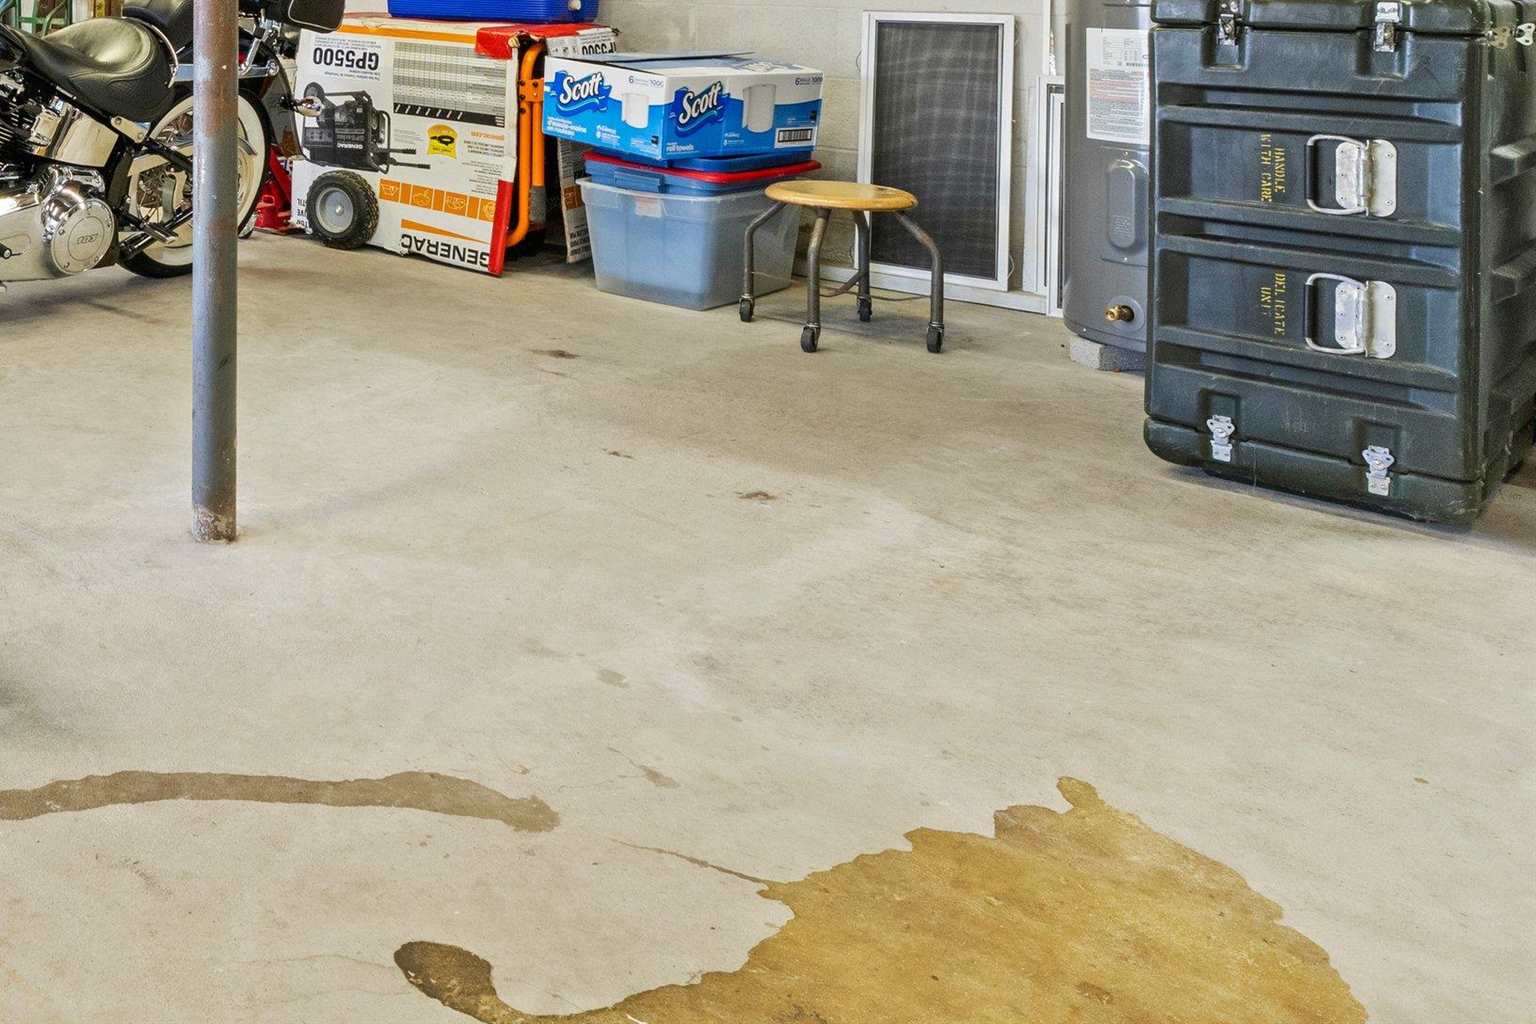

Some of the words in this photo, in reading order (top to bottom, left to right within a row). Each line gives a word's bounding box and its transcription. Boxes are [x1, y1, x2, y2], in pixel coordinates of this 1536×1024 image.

[313, 47, 379, 71] GP5500
[559, 72, 603, 104] Scott
[678, 82, 722, 124] Scott
[1275, 147, 1286, 192] HANDLE
[1261, 173, 1272, 202] CARE
[401, 234, 489, 268] GENERAC
[1275, 273, 1286, 335] DELICATE
